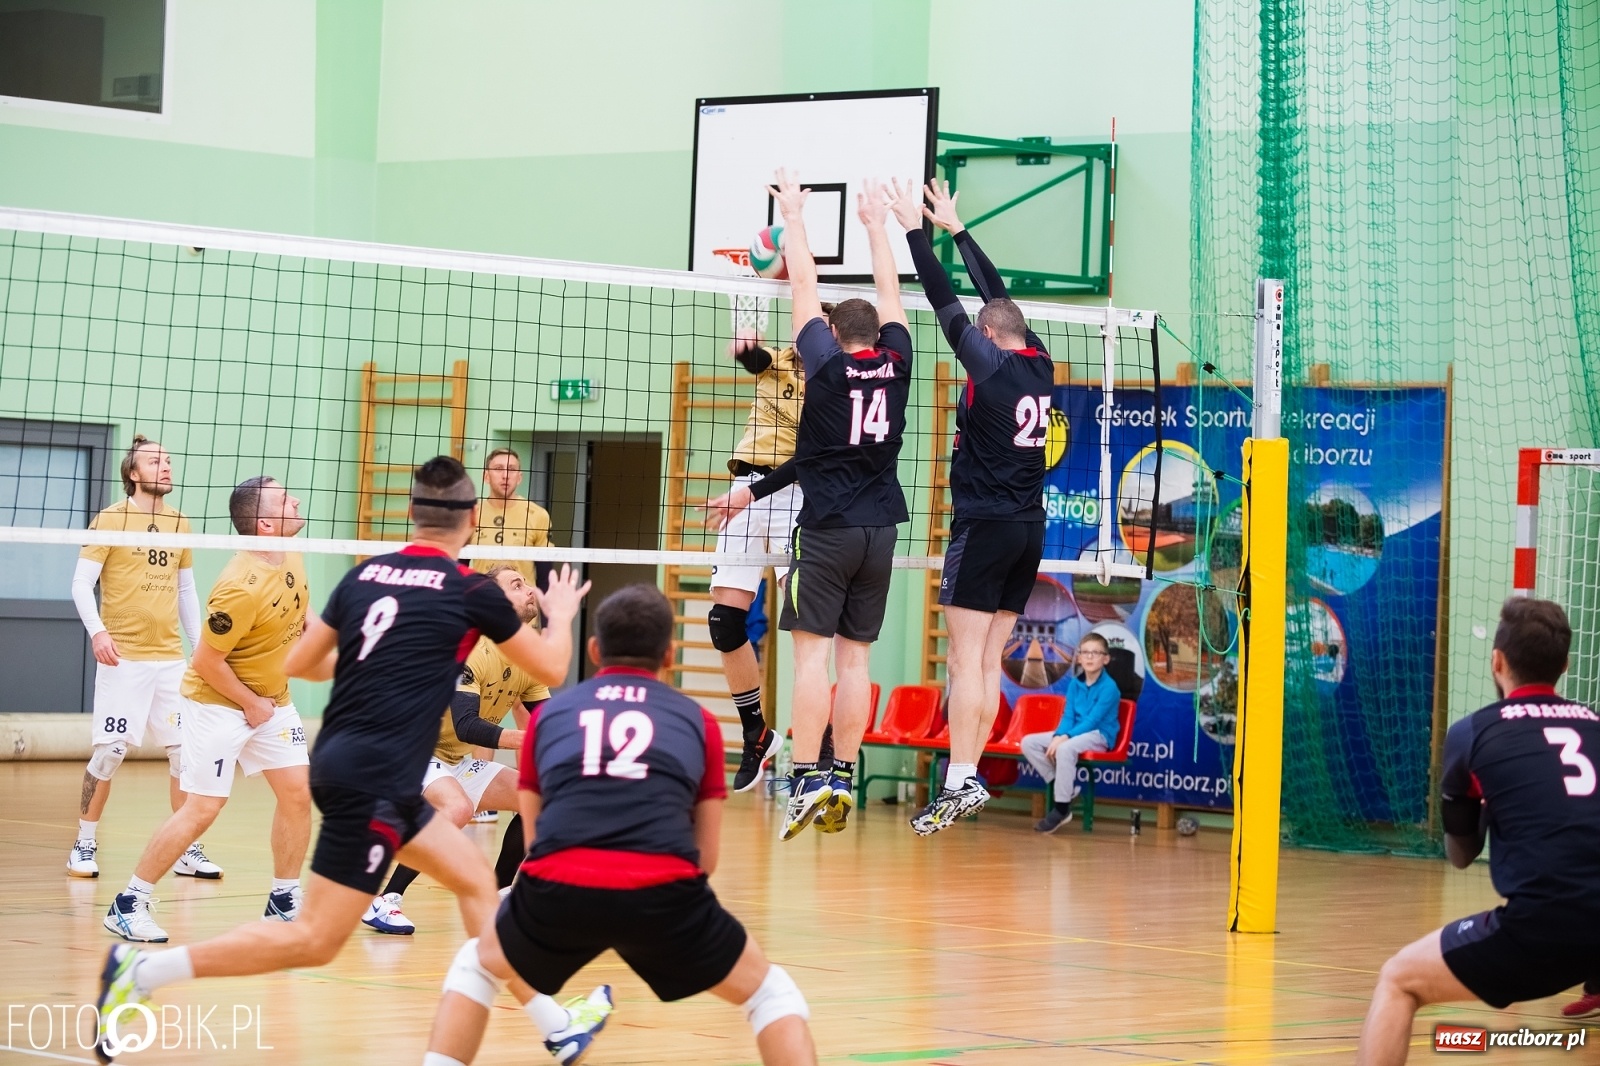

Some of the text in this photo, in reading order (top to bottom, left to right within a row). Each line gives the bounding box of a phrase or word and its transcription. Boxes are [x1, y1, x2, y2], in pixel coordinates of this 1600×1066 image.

[849, 388, 890, 446] 14
[1013, 395, 1051, 448] 25
[1281, 408, 1376, 436] ekreacji
[494, 532, 503, 544] 6
[148, 549, 168, 567] 88
[357, 595, 399, 661] 9
[595, 685, 647, 703] #LI
[104, 716, 127, 733] 88
[579, 709, 654, 780] 12
[1127, 740, 1174, 763] orz.pl
[214, 758, 224, 777] 1
[1543, 727, 1597, 797] 3
[365, 844, 385, 874] 9
